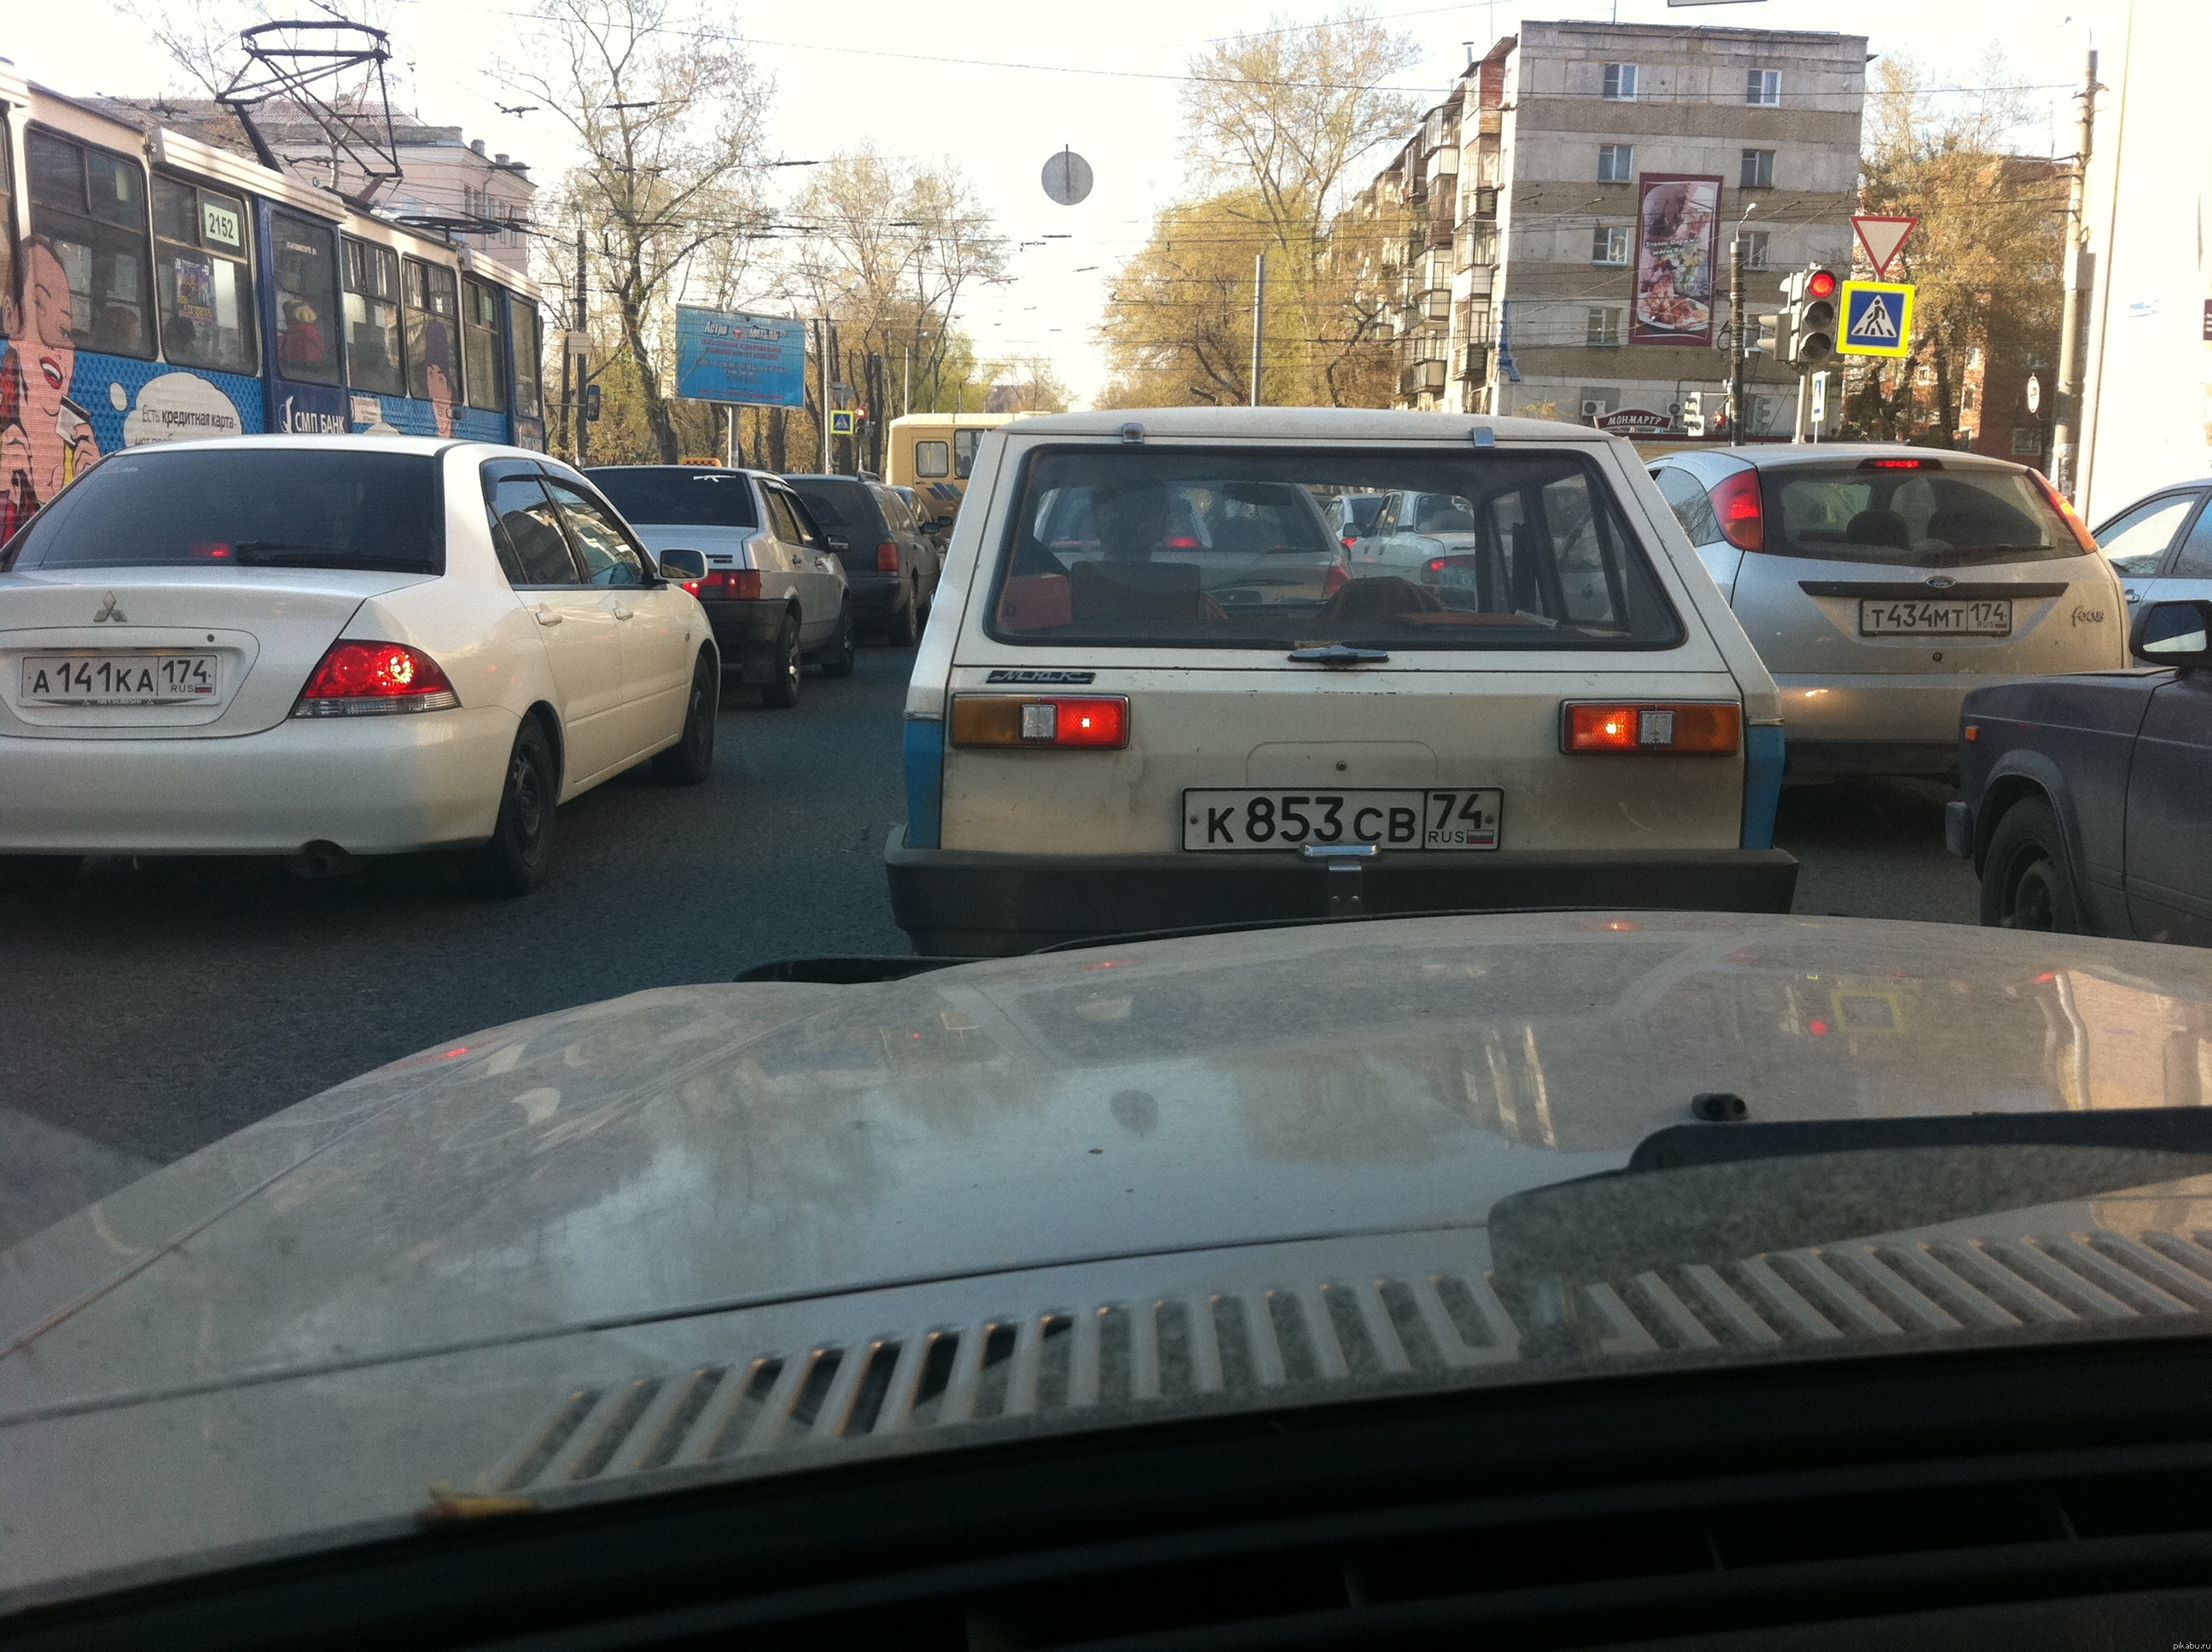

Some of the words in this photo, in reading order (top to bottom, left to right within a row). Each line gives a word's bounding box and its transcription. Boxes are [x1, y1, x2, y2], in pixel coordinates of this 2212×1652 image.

[208, 212, 234, 240] 2152
[142, 404, 160, 422] Есть
[161, 410, 210, 428] кредитная
[294, 410, 318, 433] СМП
[320, 414, 346, 433] БАНК
[1970, 602, 2005, 622] 174
[1976, 620, 1995, 629] RUS
[161, 660, 208, 683] 174
[170, 683, 195, 694] RUS
[1432, 793, 1482, 830] 74
[1428, 830, 1465, 844] RUS
